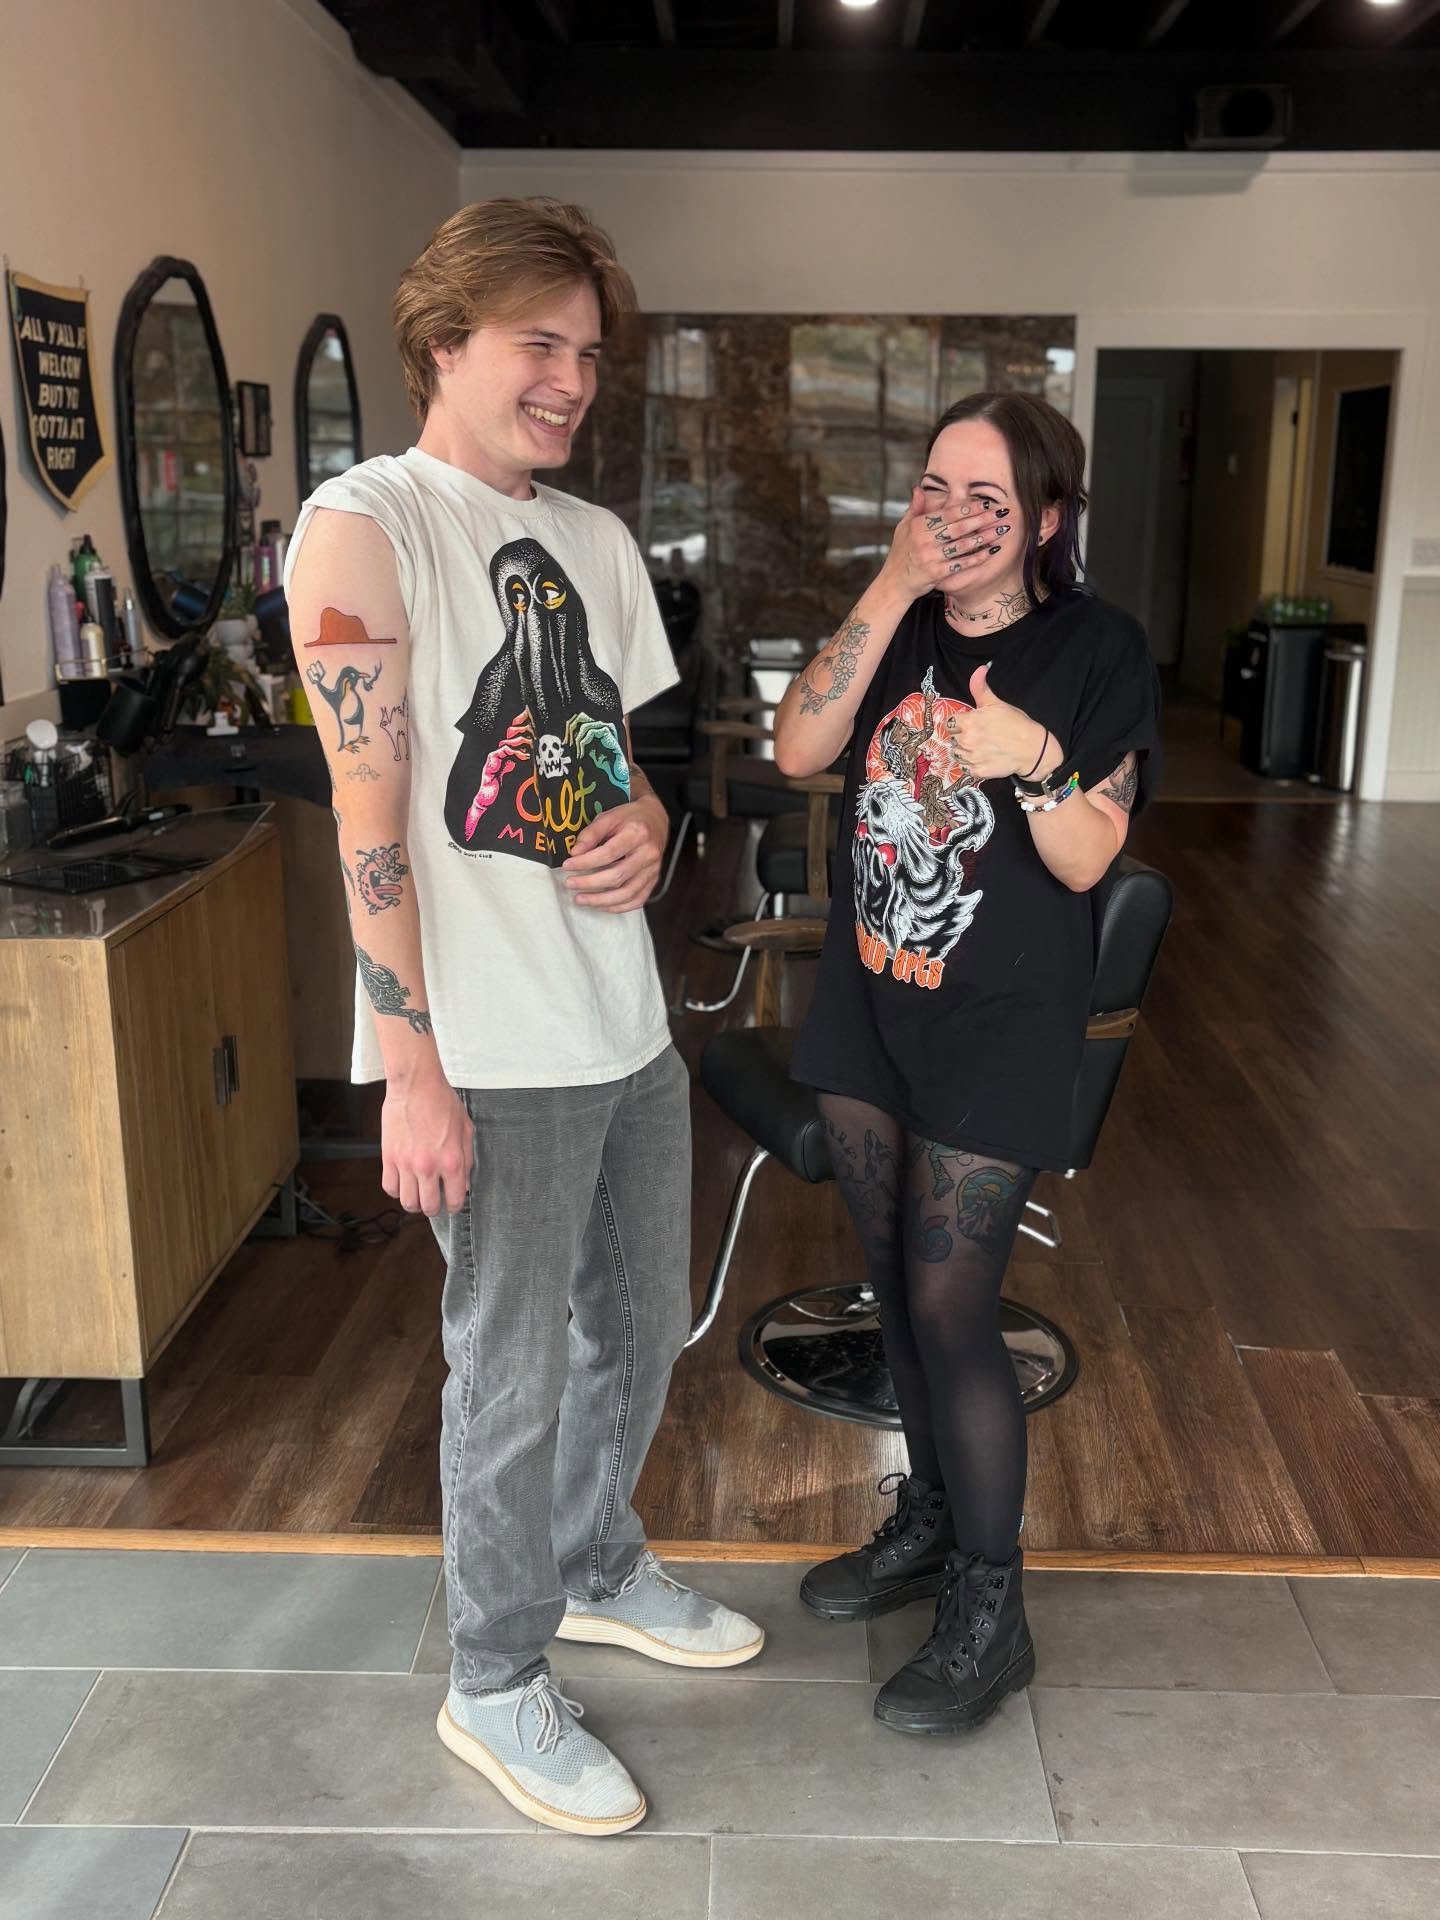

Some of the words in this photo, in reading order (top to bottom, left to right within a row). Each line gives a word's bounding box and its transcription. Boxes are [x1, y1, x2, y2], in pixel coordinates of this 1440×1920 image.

[20, 315, 46, 342] ALL
[38, 351, 82, 380] WELCOM
[38, 382, 64, 409] BUT
[65, 386, 80, 410] YO
[497, 823, 577, 855] MEMB
